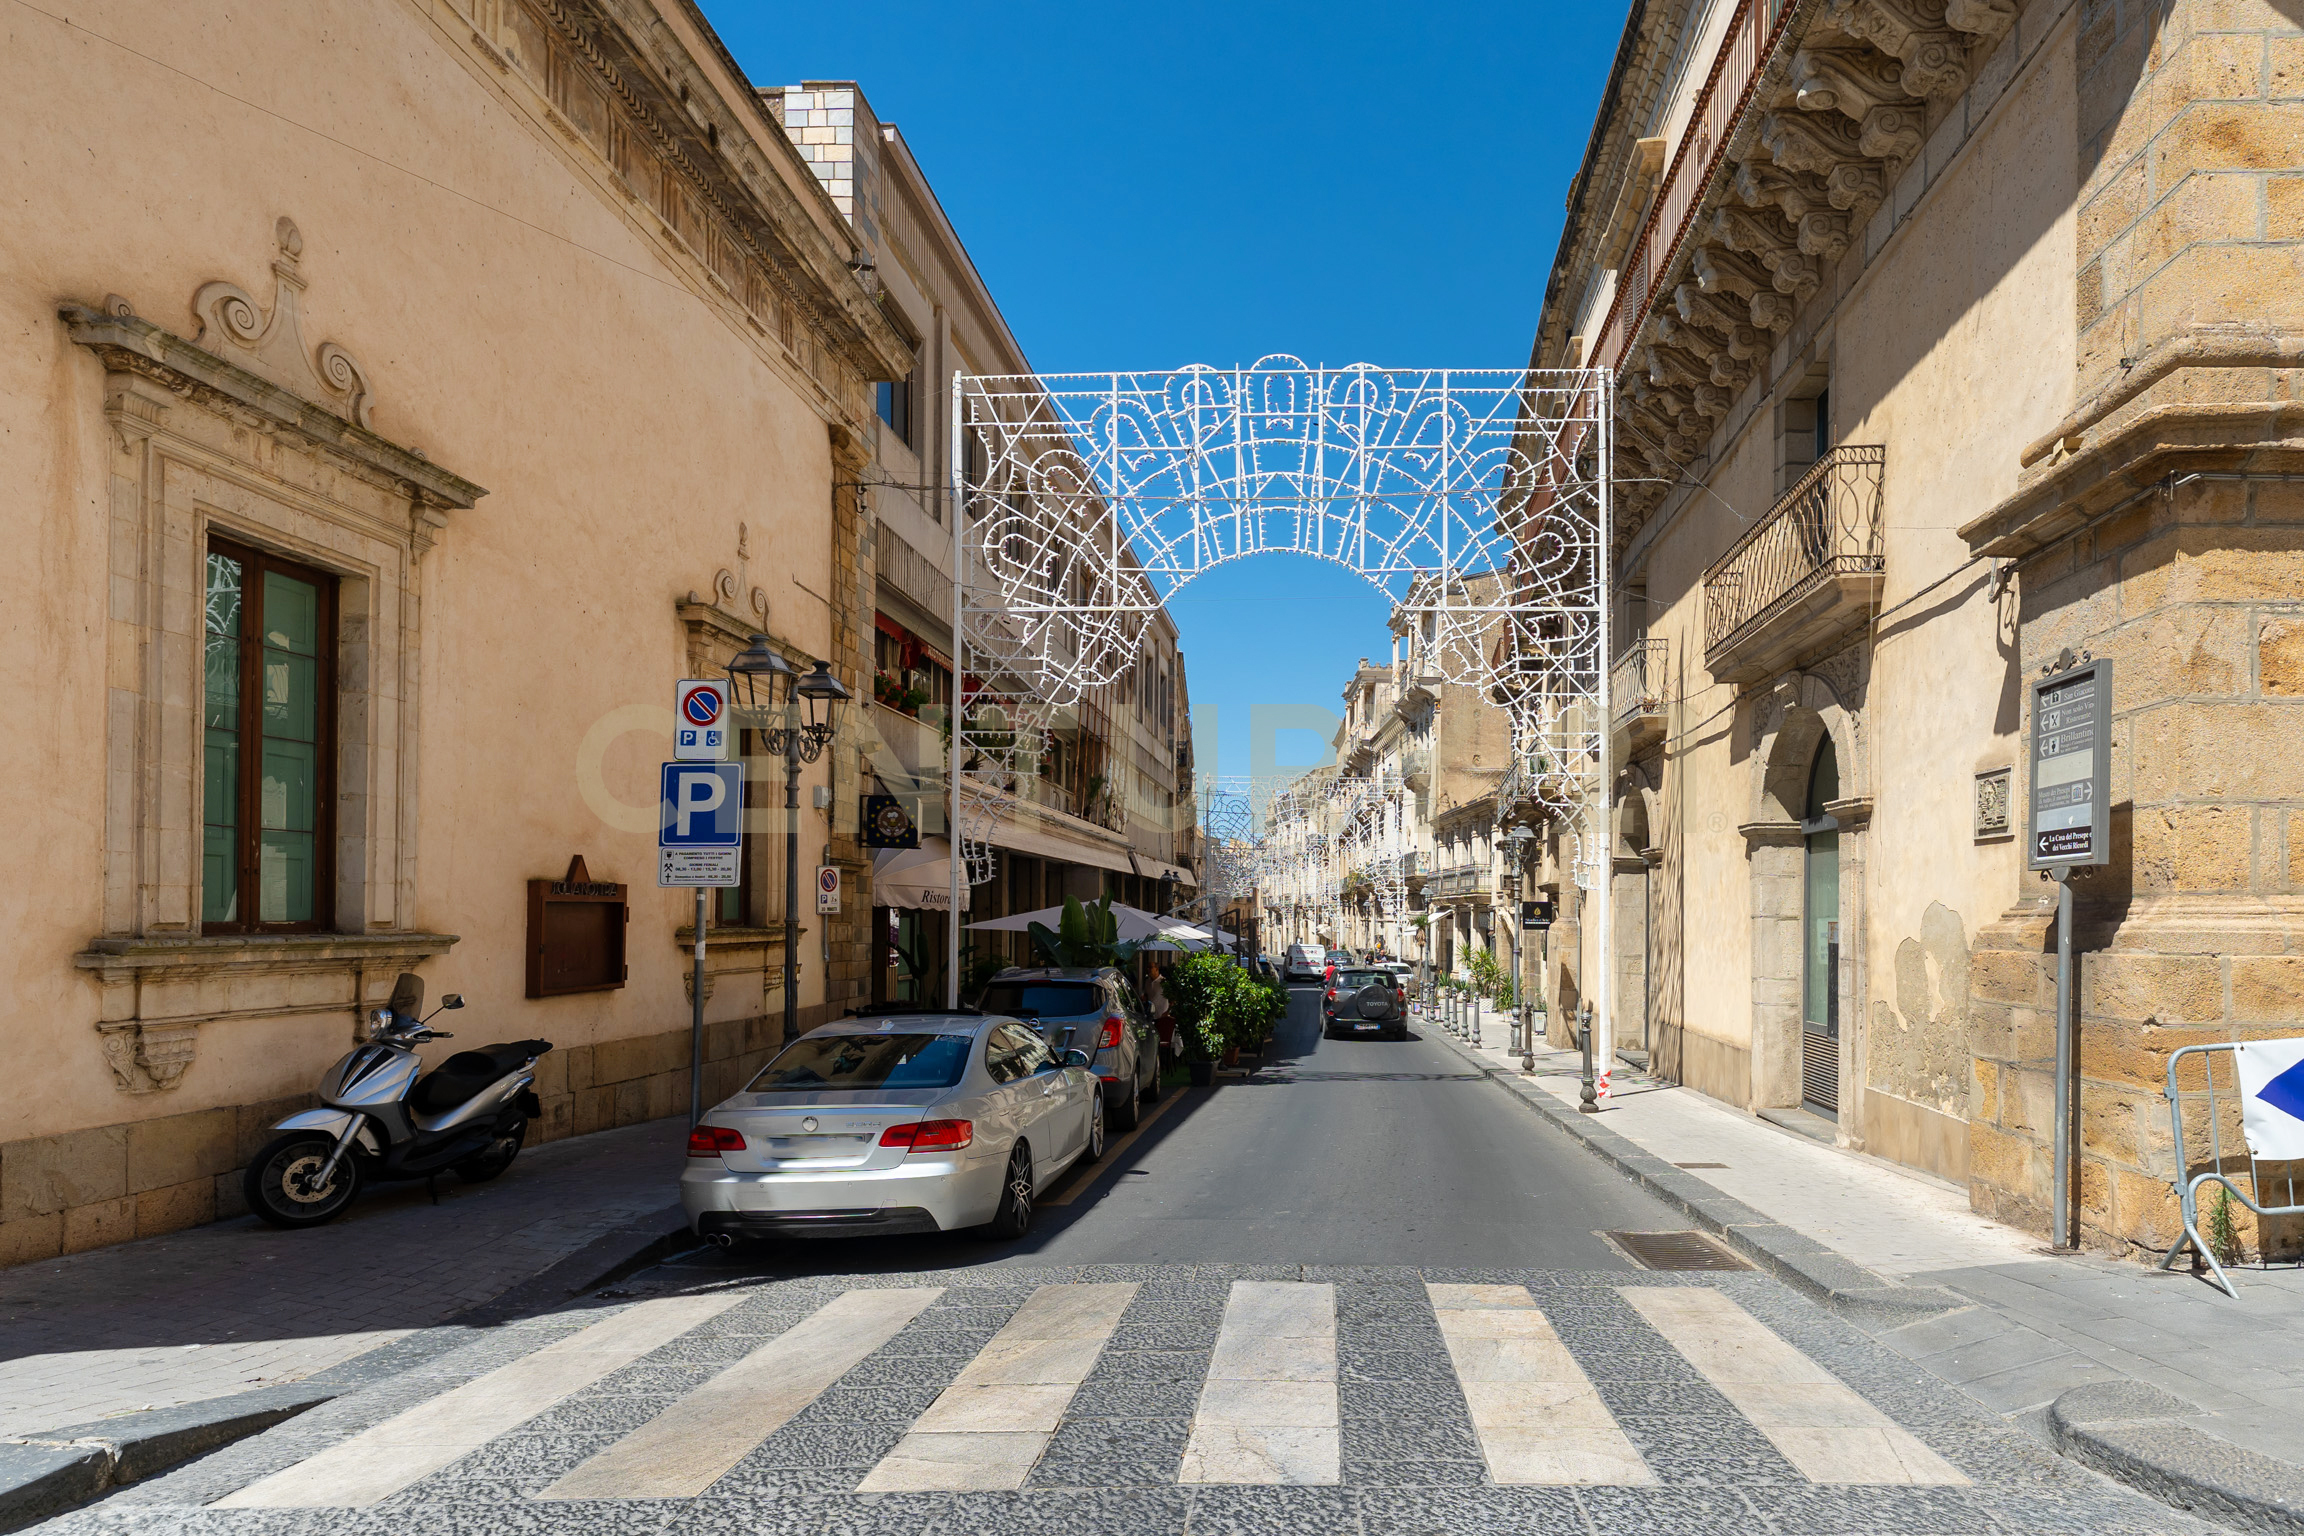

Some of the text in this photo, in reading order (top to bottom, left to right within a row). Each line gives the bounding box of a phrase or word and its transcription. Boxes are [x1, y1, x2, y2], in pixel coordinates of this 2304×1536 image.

[927, 645, 953, 670] RISTORANT
[683, 731, 694, 744] P
[676, 772, 726, 836] P
[2073, 832, 2089, 840] Presepe
[2073, 841, 2089, 849] Ricordi
